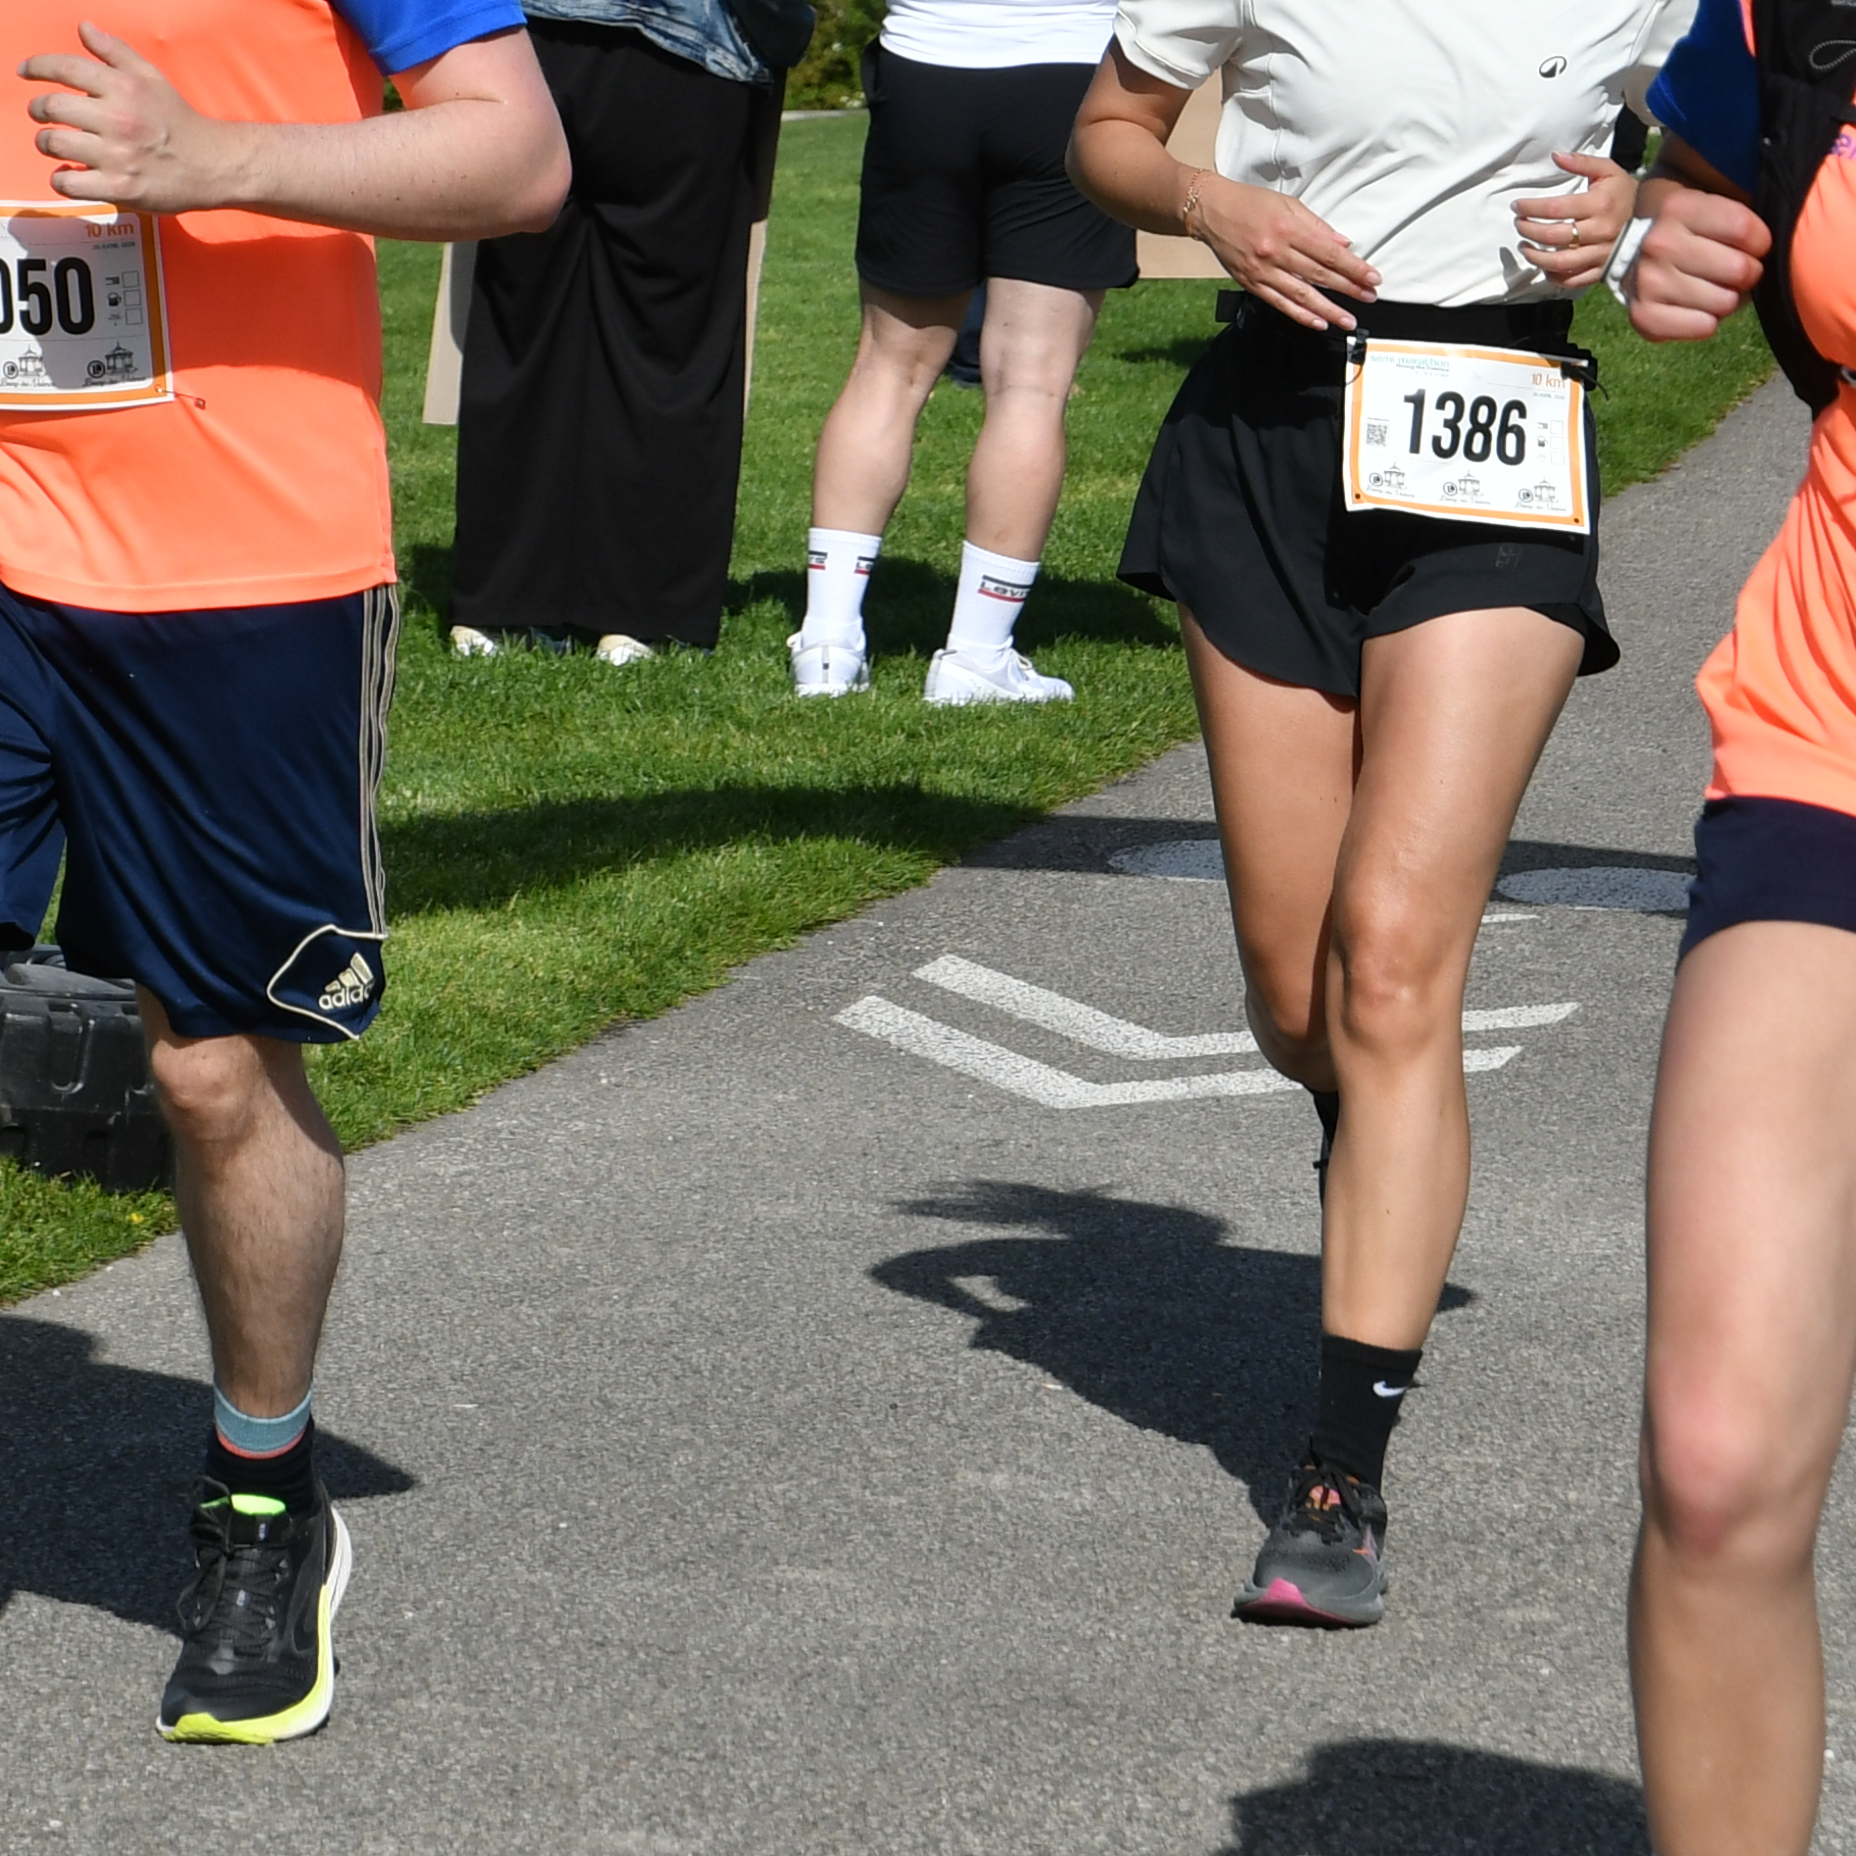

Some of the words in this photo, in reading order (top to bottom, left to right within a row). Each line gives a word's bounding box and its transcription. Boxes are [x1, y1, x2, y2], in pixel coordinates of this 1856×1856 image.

[84, 224, 102, 239] 10
[107, 222, 135, 236] km
[1370, 354, 1450, 369] semi-marathon
[1530, 373, 1543, 386] 10
[1546, 373, 1566, 390] km
[1403, 388, 1527, 466] 1386
